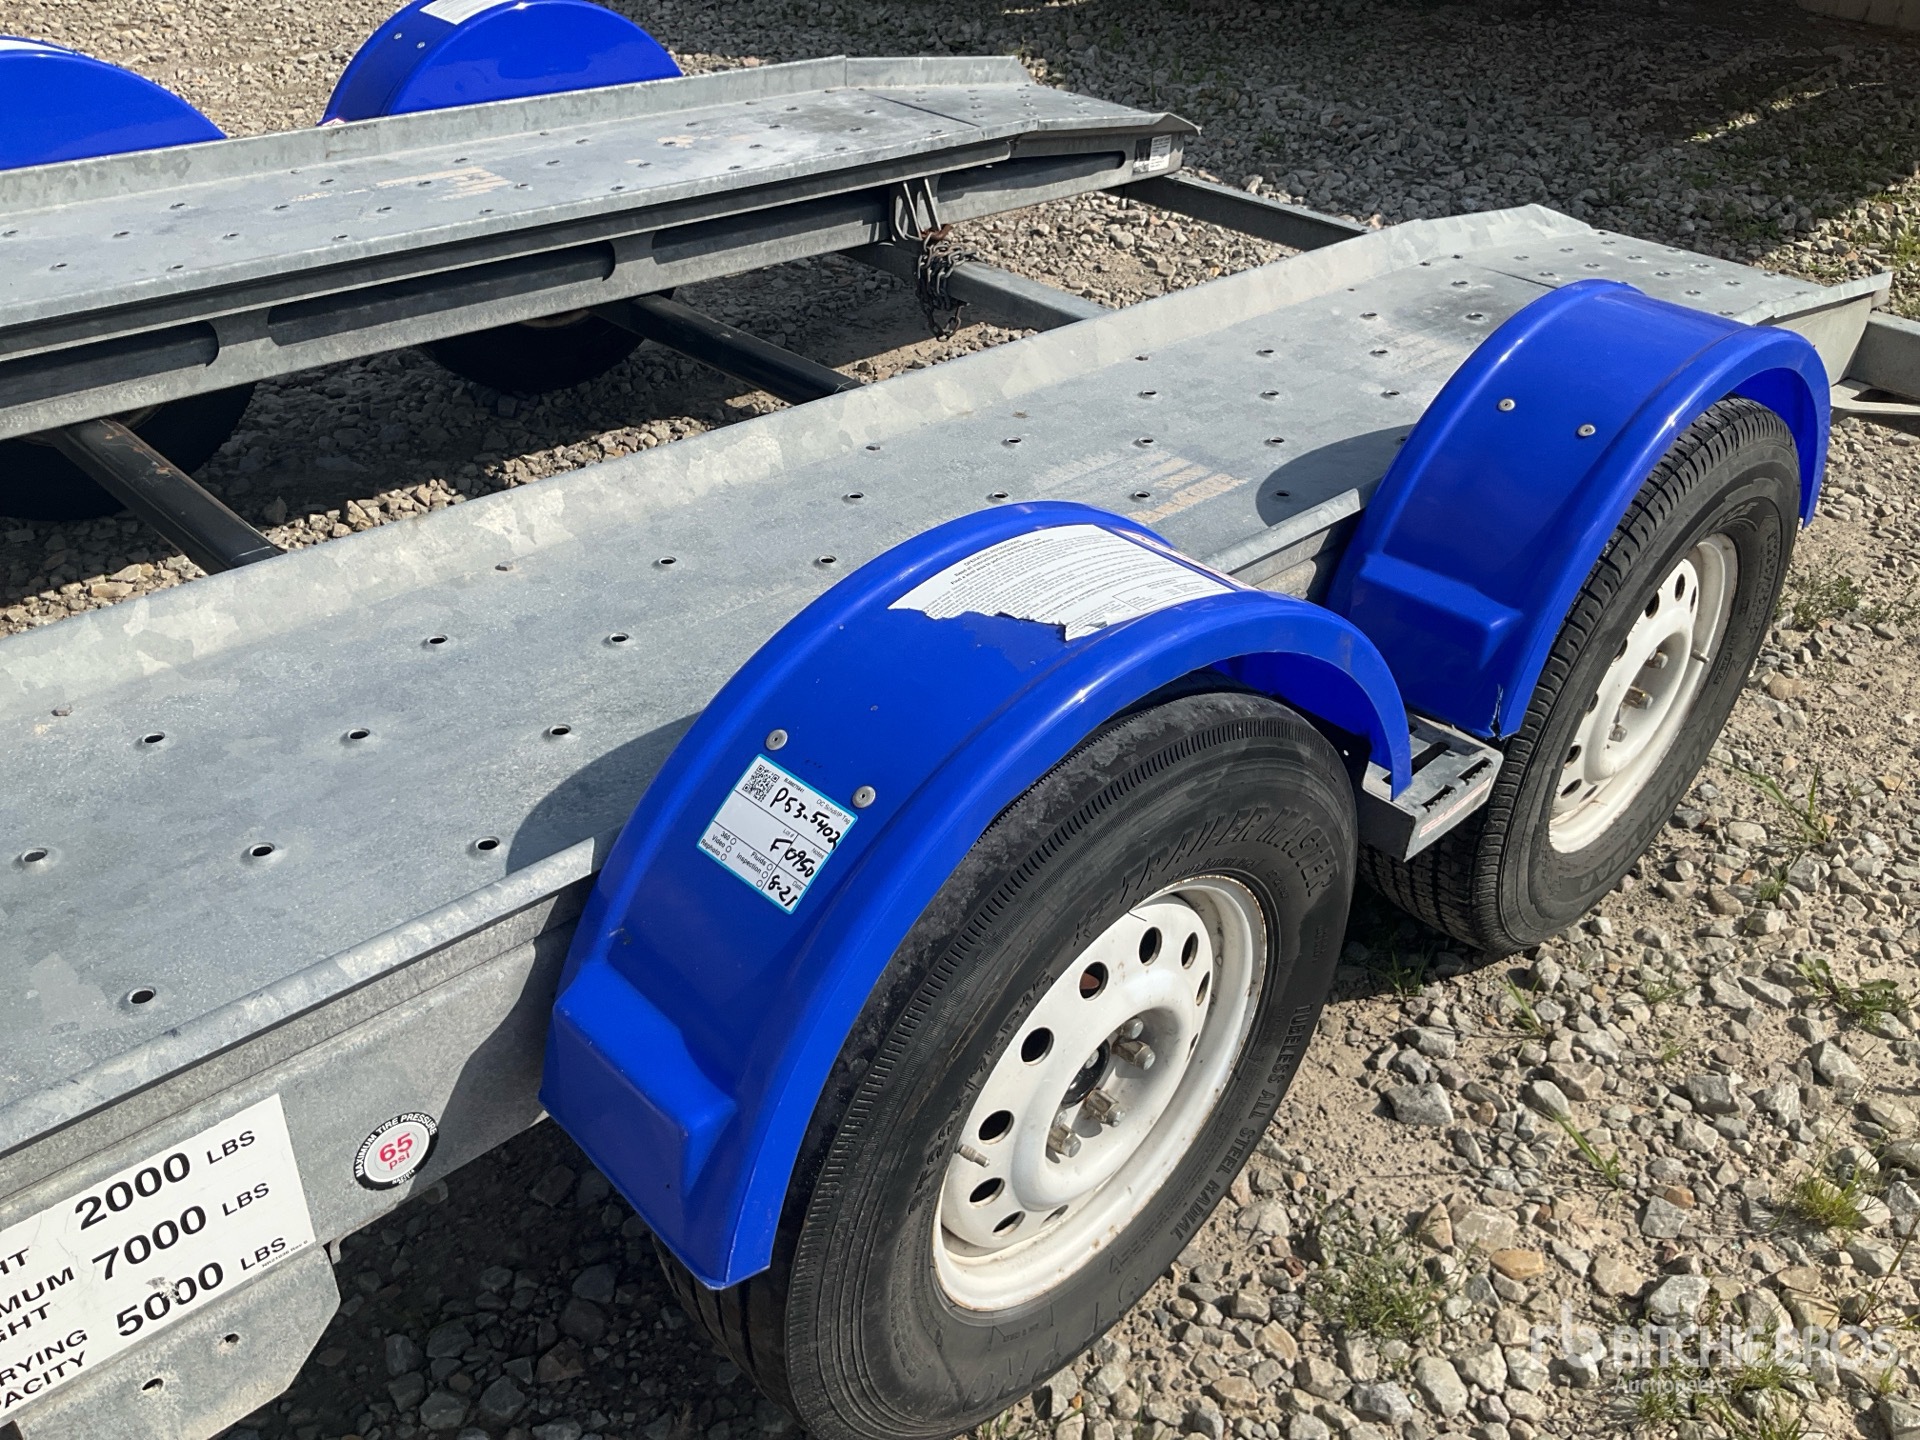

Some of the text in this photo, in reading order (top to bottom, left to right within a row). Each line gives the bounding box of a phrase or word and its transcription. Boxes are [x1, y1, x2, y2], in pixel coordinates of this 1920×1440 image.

[701, 839, 721, 856] Rephoto
[712, 835, 726, 848] Video
[720, 831, 731, 841] 360
[736, 852, 762, 874] Inspection
[750, 851, 767, 866] Fluids
[812, 847, 824, 859] Notes
[1256, 807, 1340, 897] MASTER
[792, 880, 803, 891] Date
[1170, 1003, 1313, 1242] TUBELESS ALL STEEL RADIAL
[355, 1134, 376, 1177] MAXIMUM
[376, 1117, 399, 1134] TIRE
[400, 1114, 437, 1135] PRESSURE
[379, 1132, 413, 1162] 65
[389, 1151, 410, 1170] psi
[75, 1129, 256, 1230] 2000 LBS
[92, 1182, 270, 1280] 7000 LBS
[117, 1237, 286, 1337] 5000 LBS
[0, 1351, 85, 1410] ACITY
